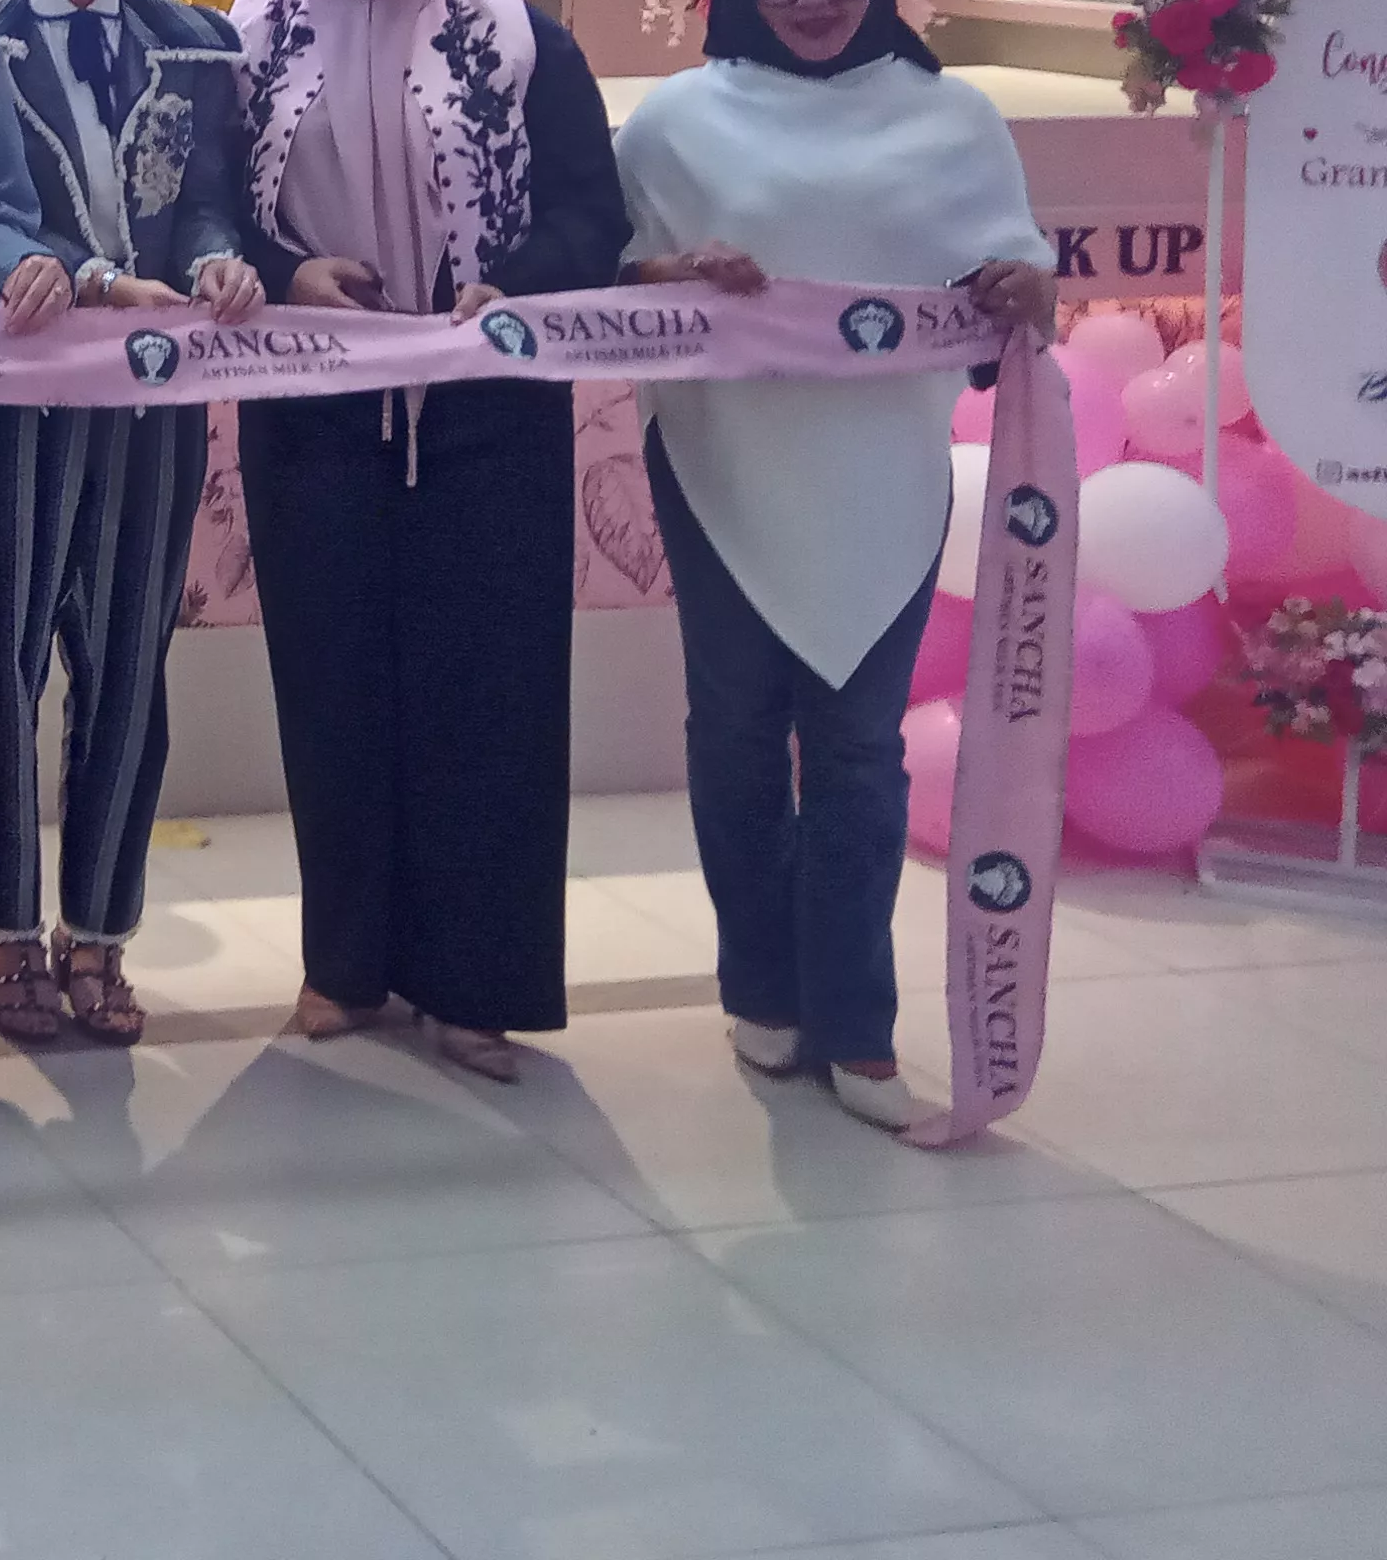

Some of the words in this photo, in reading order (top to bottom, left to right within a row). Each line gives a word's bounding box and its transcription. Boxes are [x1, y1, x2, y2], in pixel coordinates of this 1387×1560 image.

[1115, 223, 1205, 277] UP
[187, 329, 352, 360] SANCHA
[542, 307, 713, 342] SANCHA
[1006, 556, 1049, 725] SANCHA
[983, 924, 1021, 1101] SANCHA
